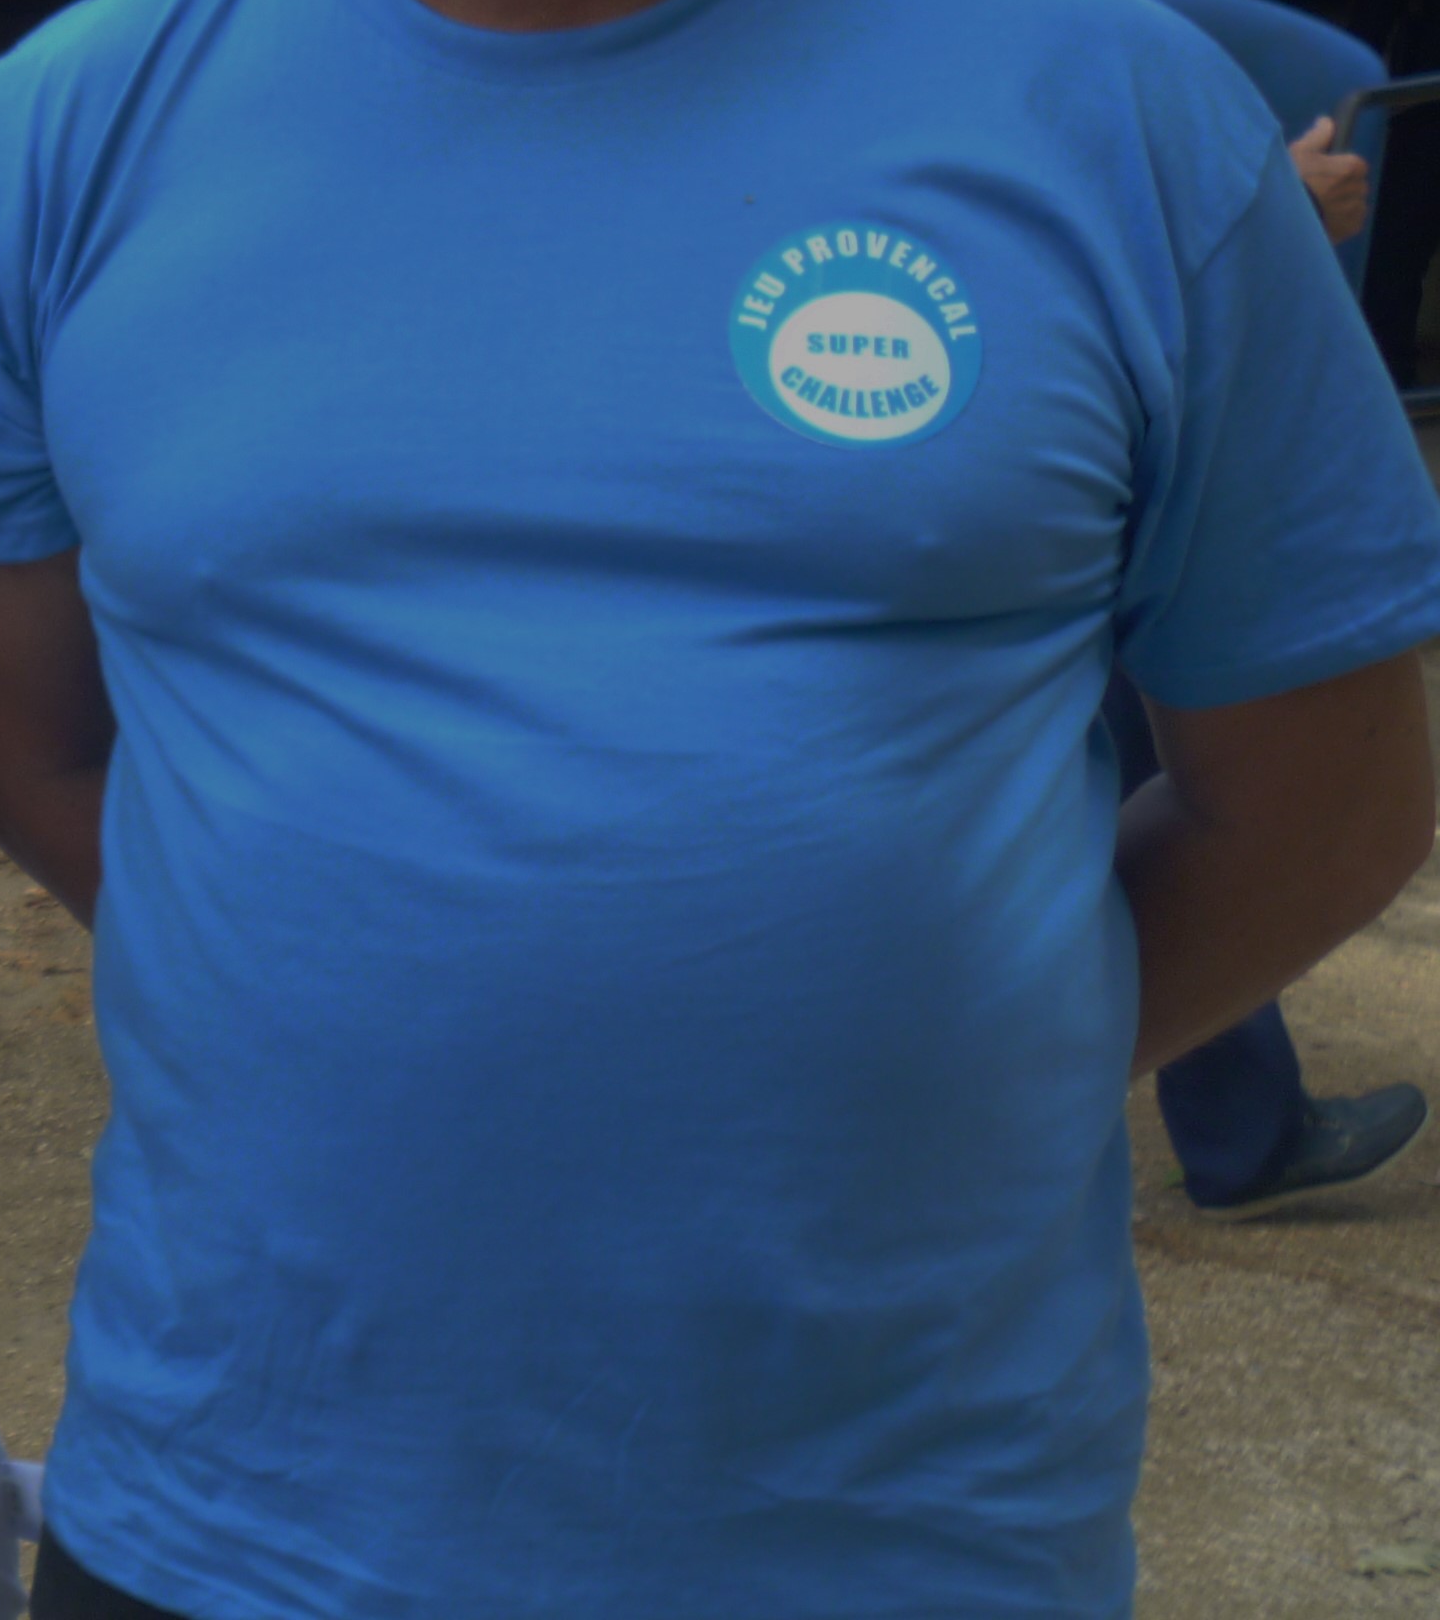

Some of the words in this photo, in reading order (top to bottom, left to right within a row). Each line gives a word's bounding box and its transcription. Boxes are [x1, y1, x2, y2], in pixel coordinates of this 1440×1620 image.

[736, 271, 786, 332] JEU
[781, 229, 977, 341] PROVENCAL
[806, 332, 912, 360] SUPER
[780, 365, 942, 419] CHALLENGE
